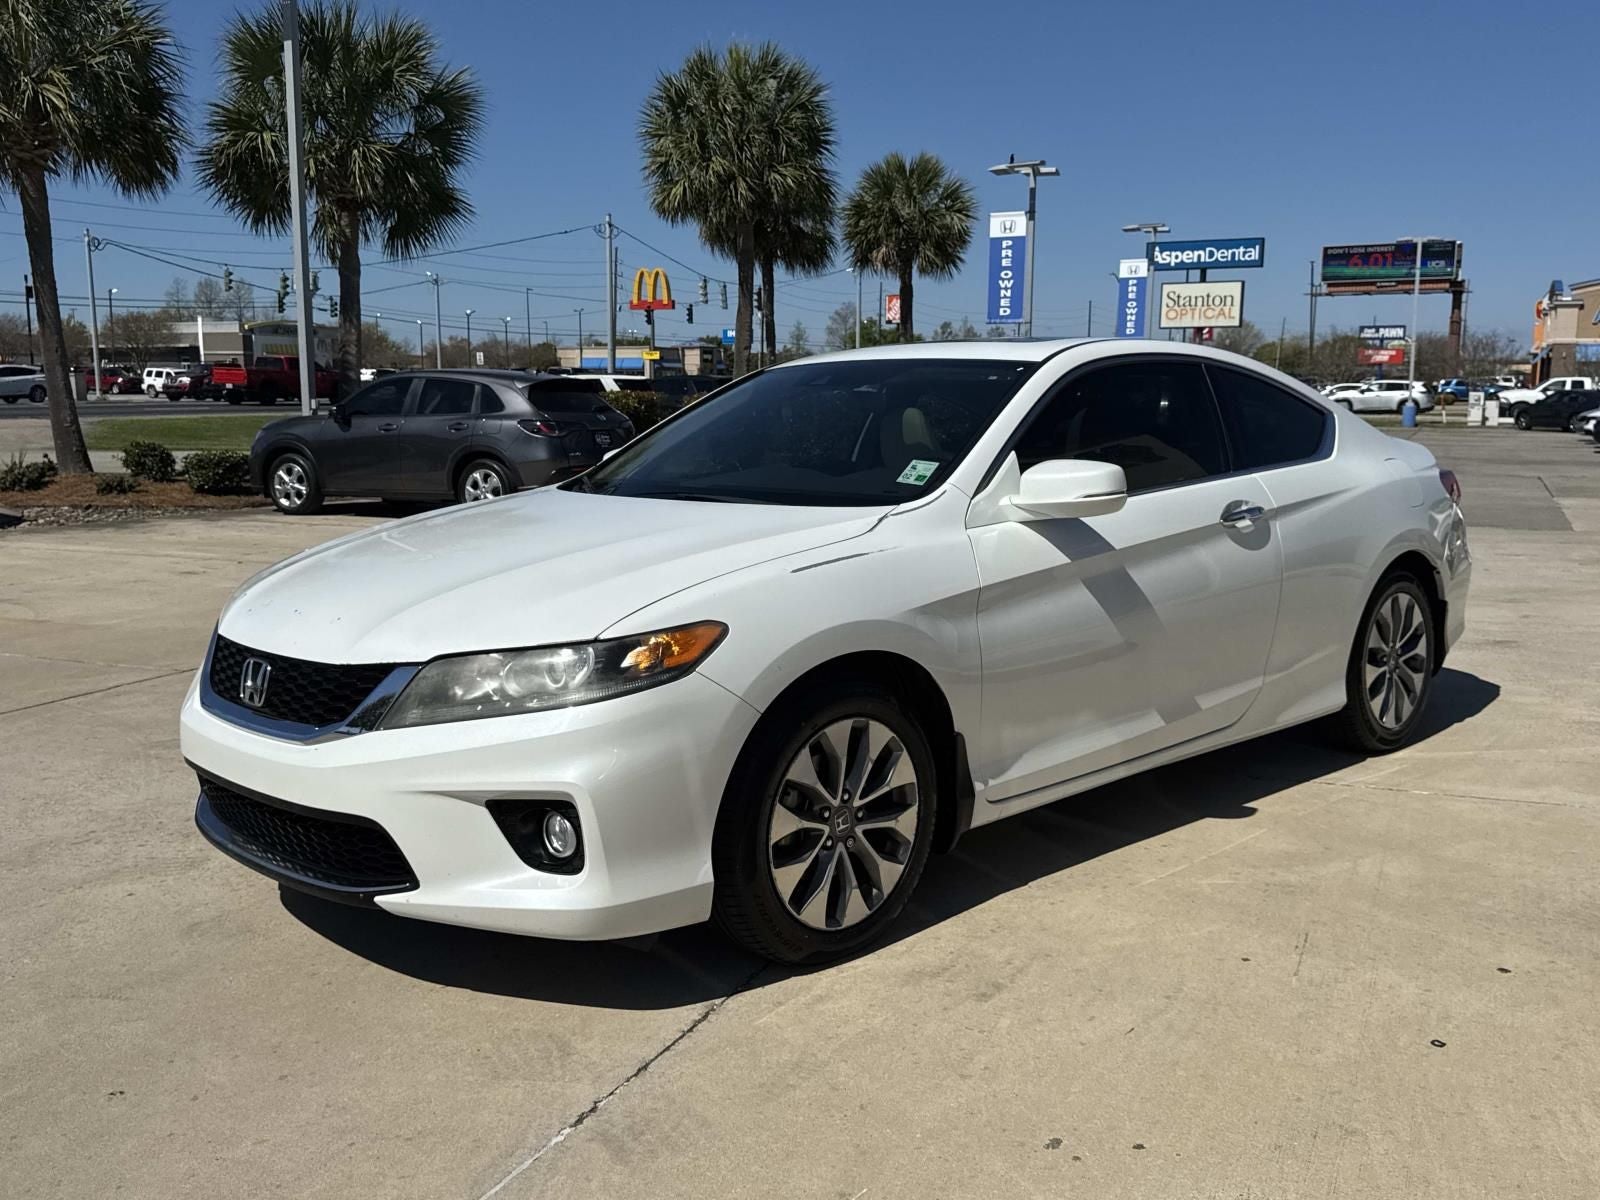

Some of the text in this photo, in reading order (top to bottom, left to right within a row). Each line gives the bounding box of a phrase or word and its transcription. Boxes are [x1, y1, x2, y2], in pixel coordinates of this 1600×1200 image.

[1327, 247, 1348, 255] DON'T
[1366, 245, 1396, 253] INTEREST
[998, 240, 1014, 316] PRE OWNED
[1166, 290, 1234, 308] Stanton
[1125, 279, 1138, 335] PRE OWNED
[1165, 307, 1235, 320] OPTICAL
[1378, 327, 1404, 338] PAWN
